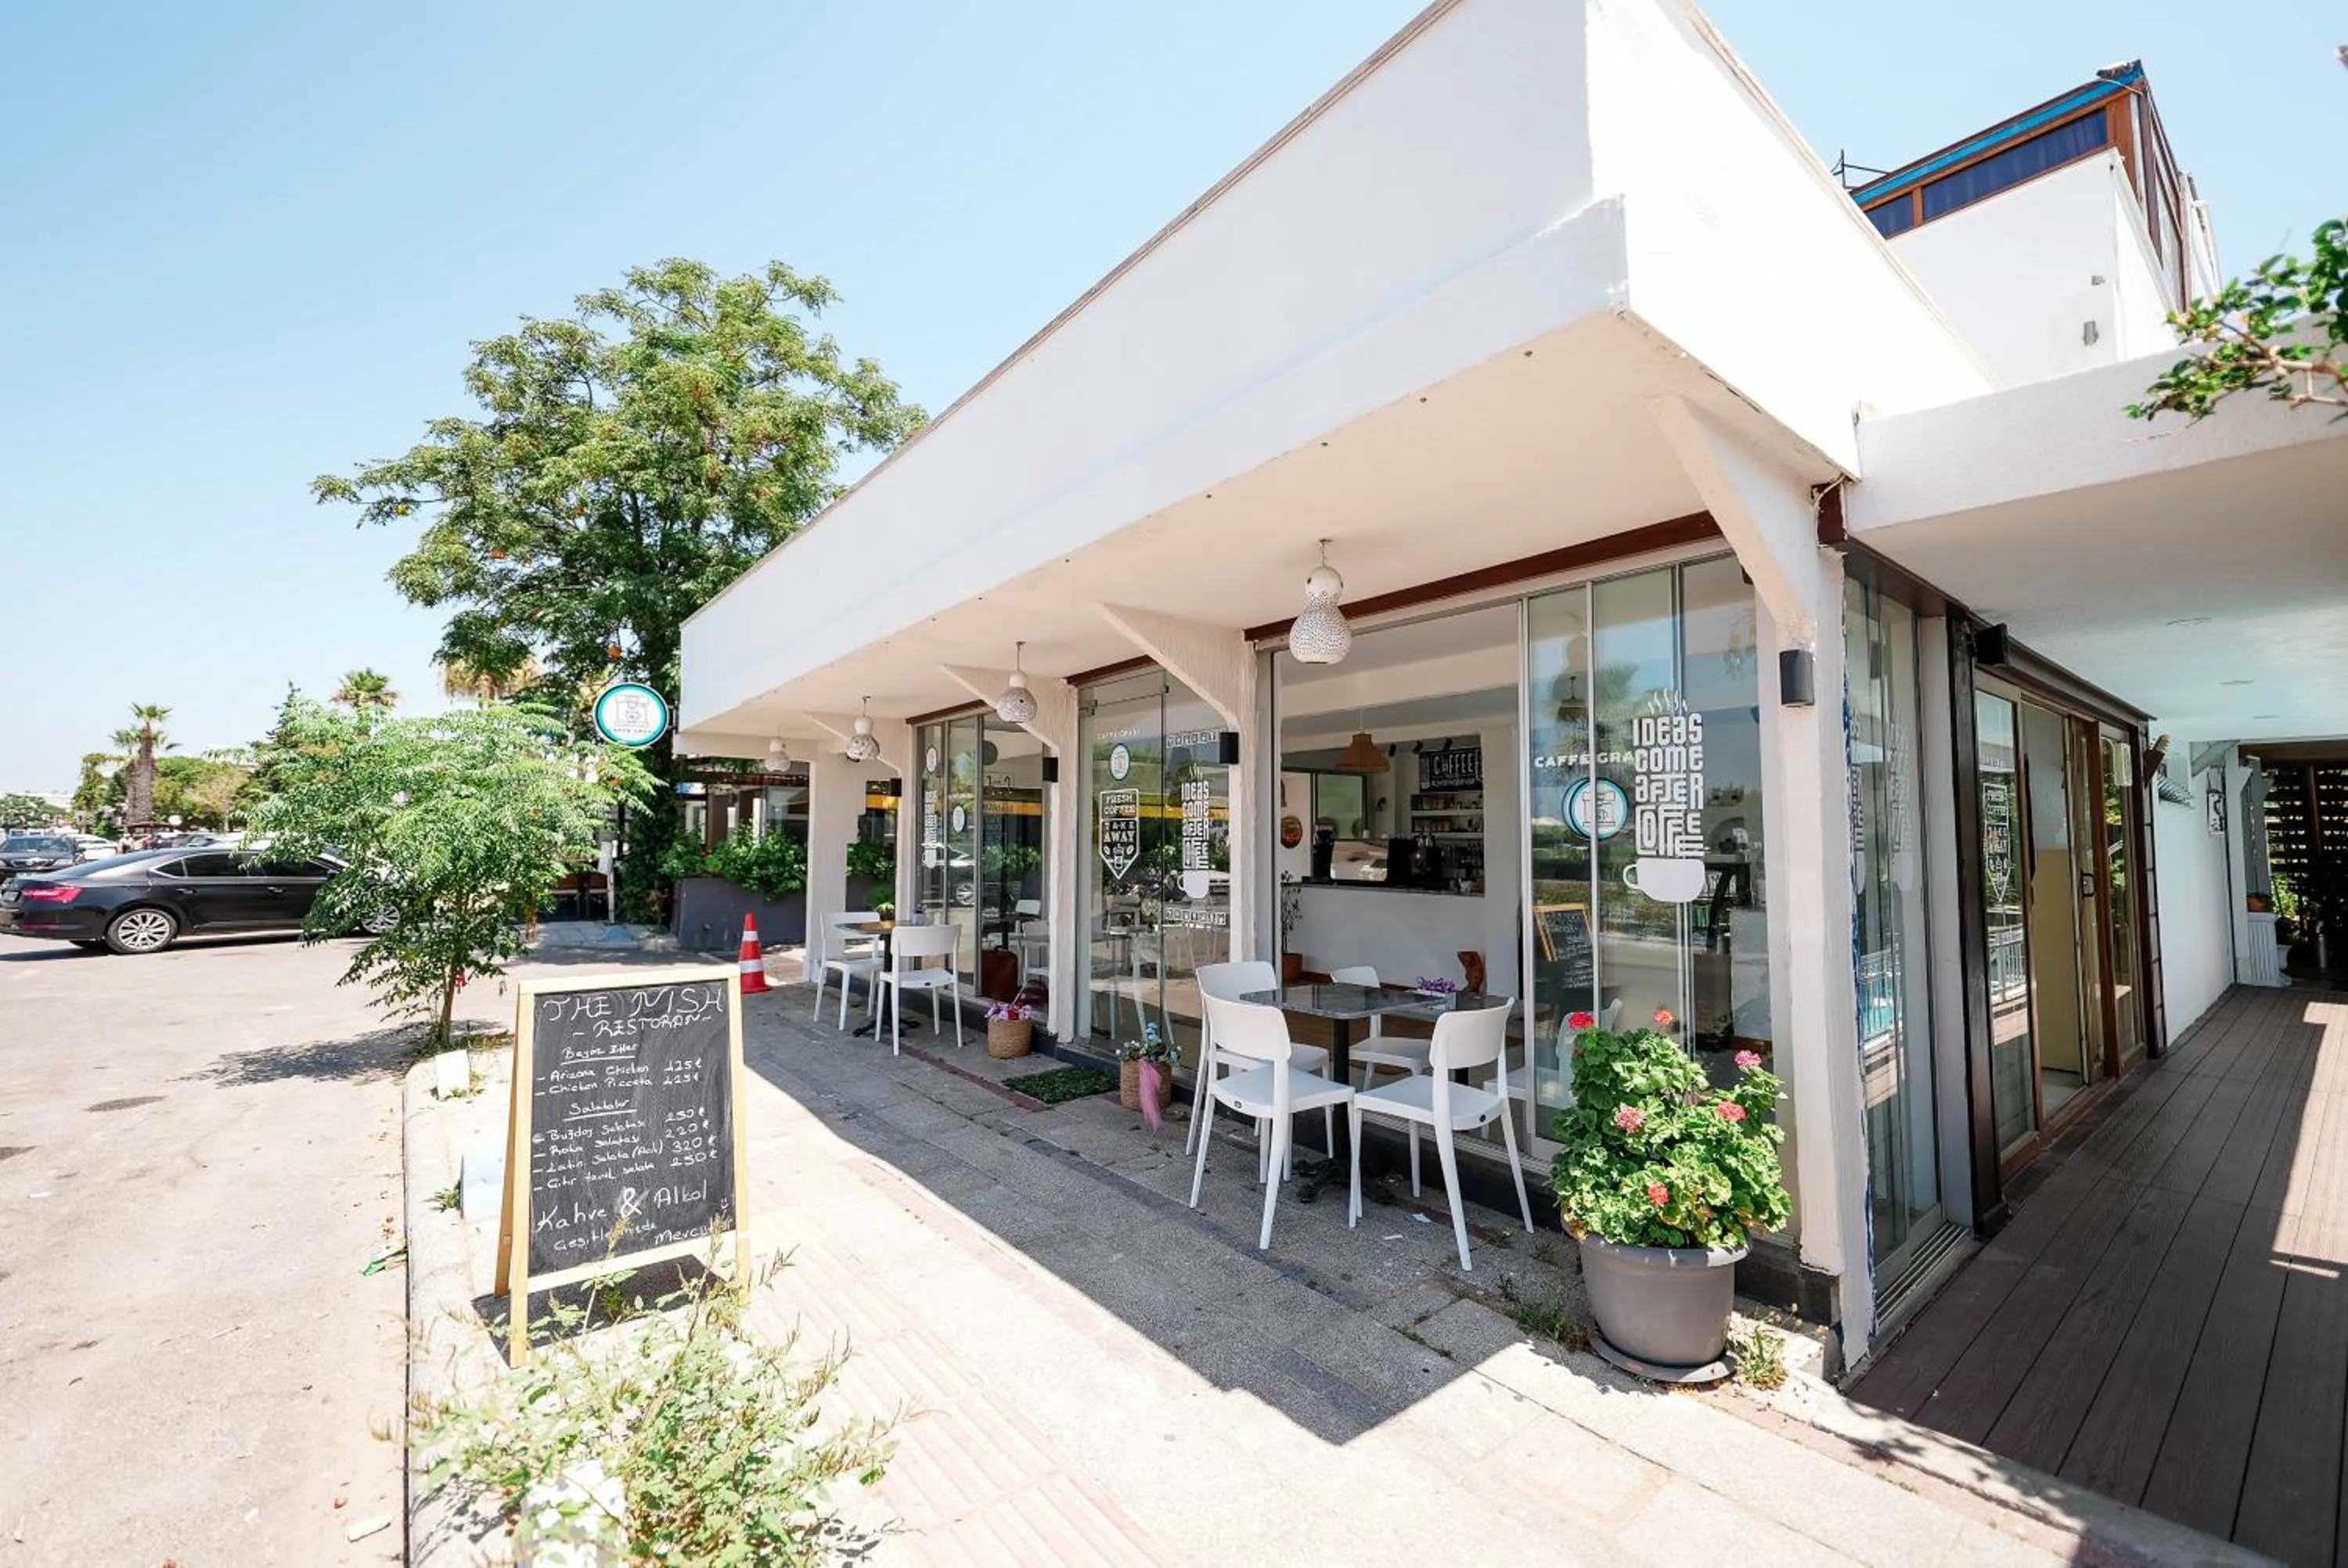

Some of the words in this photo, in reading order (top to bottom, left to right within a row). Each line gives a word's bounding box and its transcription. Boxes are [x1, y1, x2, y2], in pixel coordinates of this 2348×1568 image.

[543, 996, 613, 1021] THE
[535, 1202, 607, 1234] Kahve
[621, 1187, 643, 1217] &
[654, 1179, 707, 1209] Alkol
